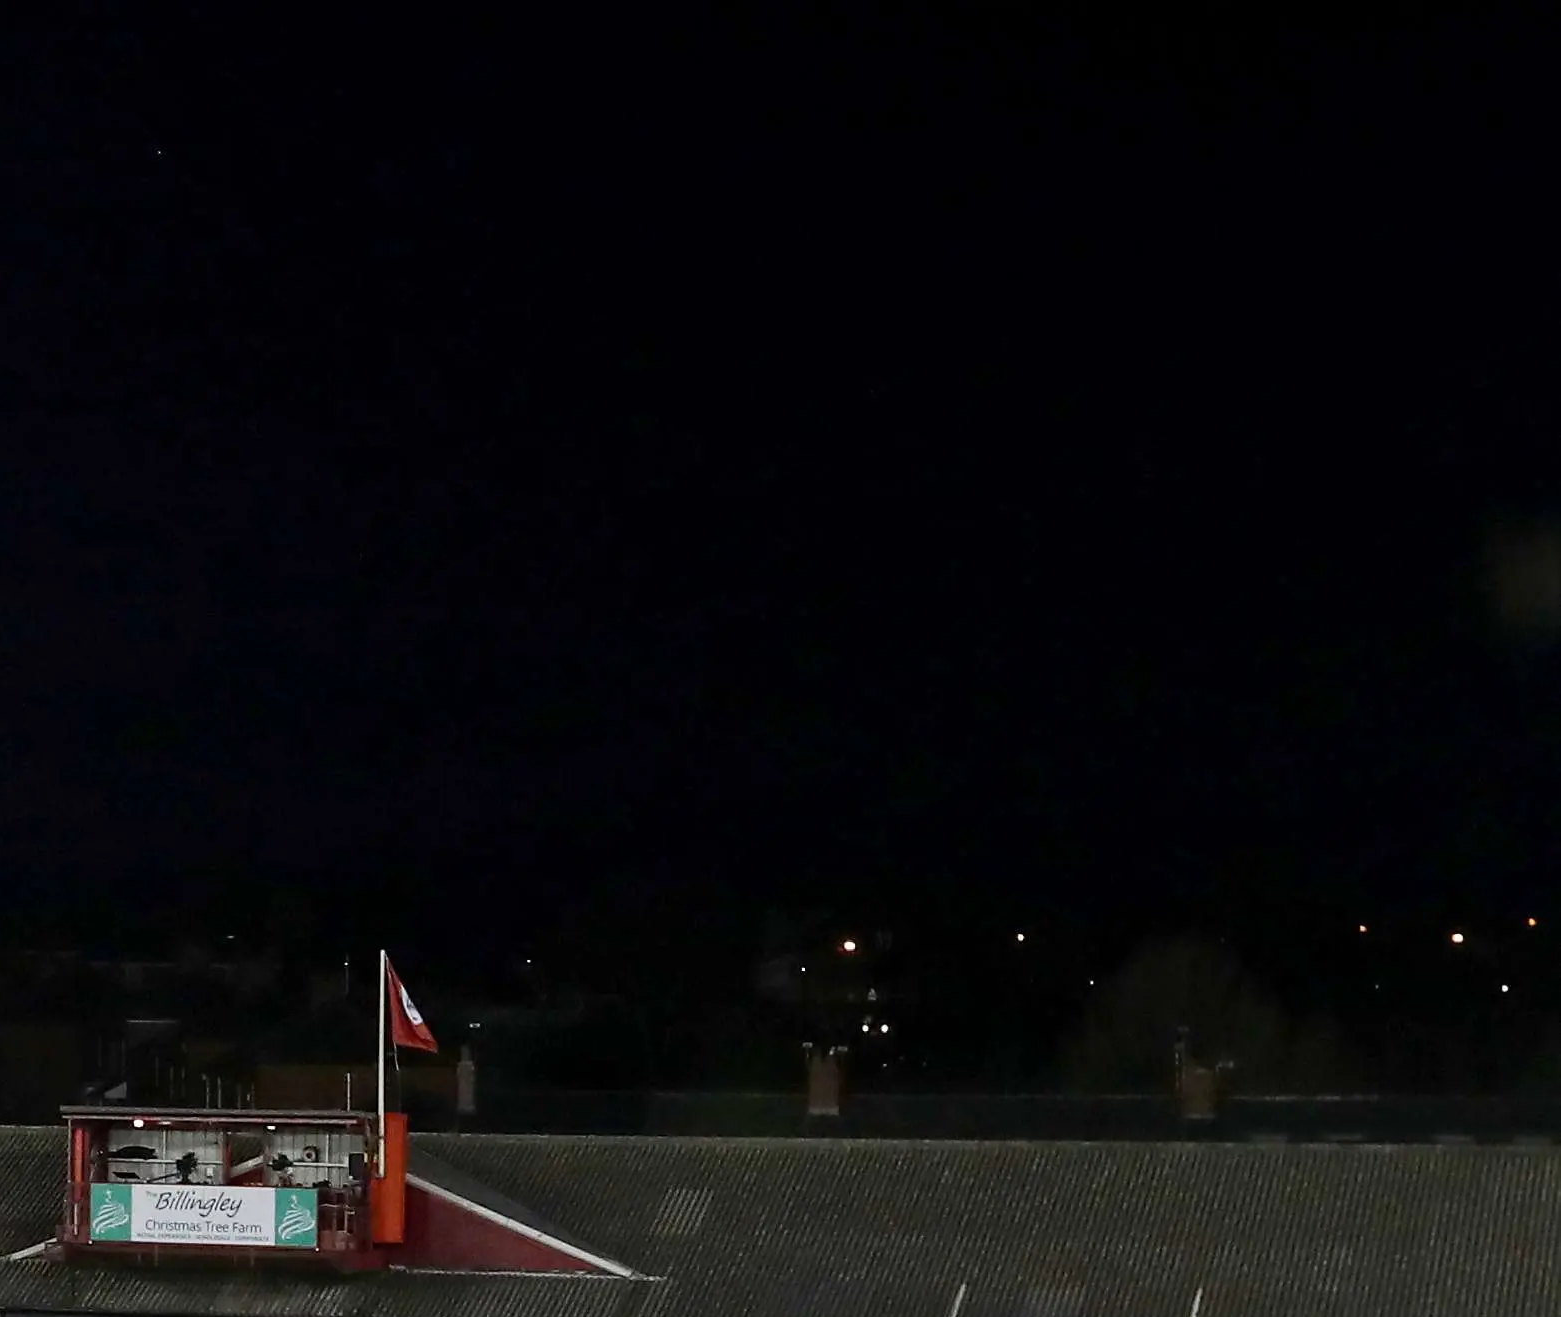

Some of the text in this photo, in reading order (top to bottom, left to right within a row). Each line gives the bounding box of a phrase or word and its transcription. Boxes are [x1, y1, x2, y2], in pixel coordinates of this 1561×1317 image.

[154, 1191, 243, 1217] Billingley
[145, 1218, 262, 1233] Christmas Tree Farm
